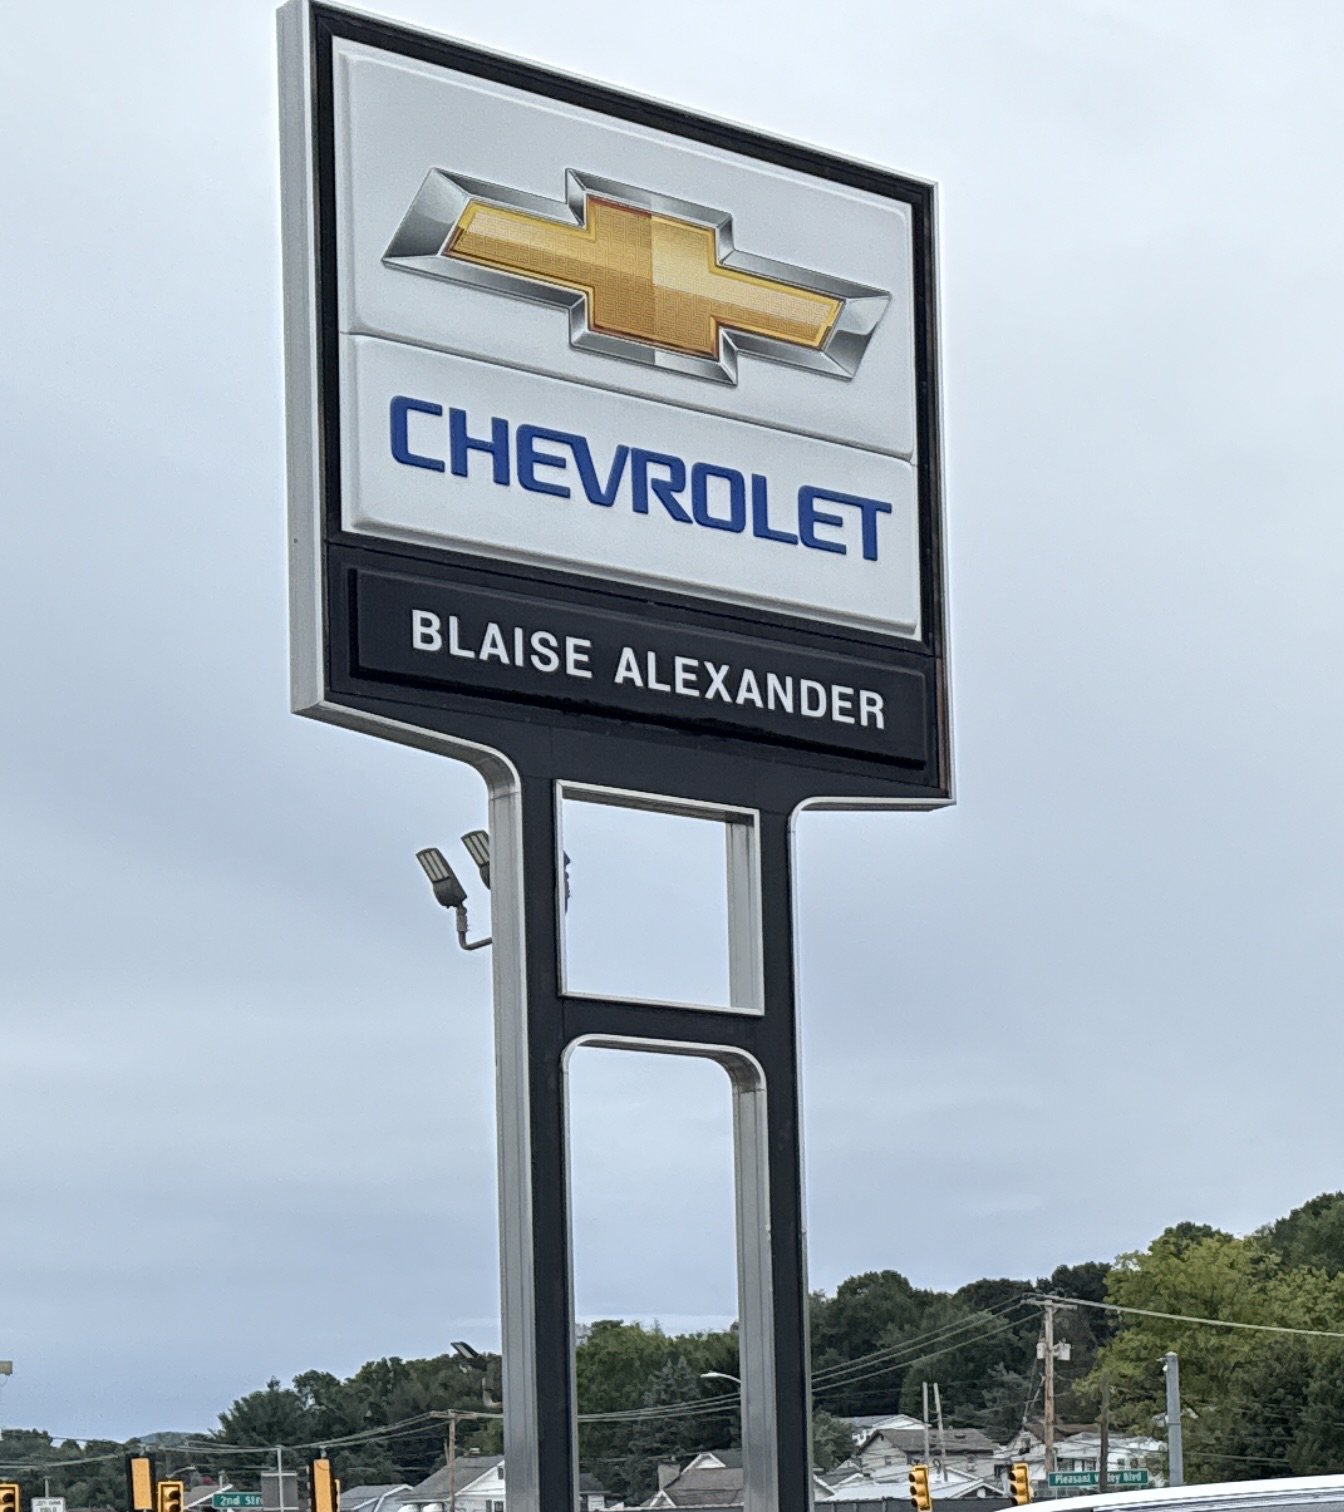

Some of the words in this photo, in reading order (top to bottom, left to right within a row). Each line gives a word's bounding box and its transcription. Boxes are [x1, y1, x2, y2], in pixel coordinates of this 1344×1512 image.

[390, 395, 893, 561] CHEVROLET
[411, 610, 593, 679] BLAISE
[614, 646, 886, 730] ALEXANDER
[220, 1496, 240, 1506] 2nd
[1094, 1473, 1121, 1484] Vley
